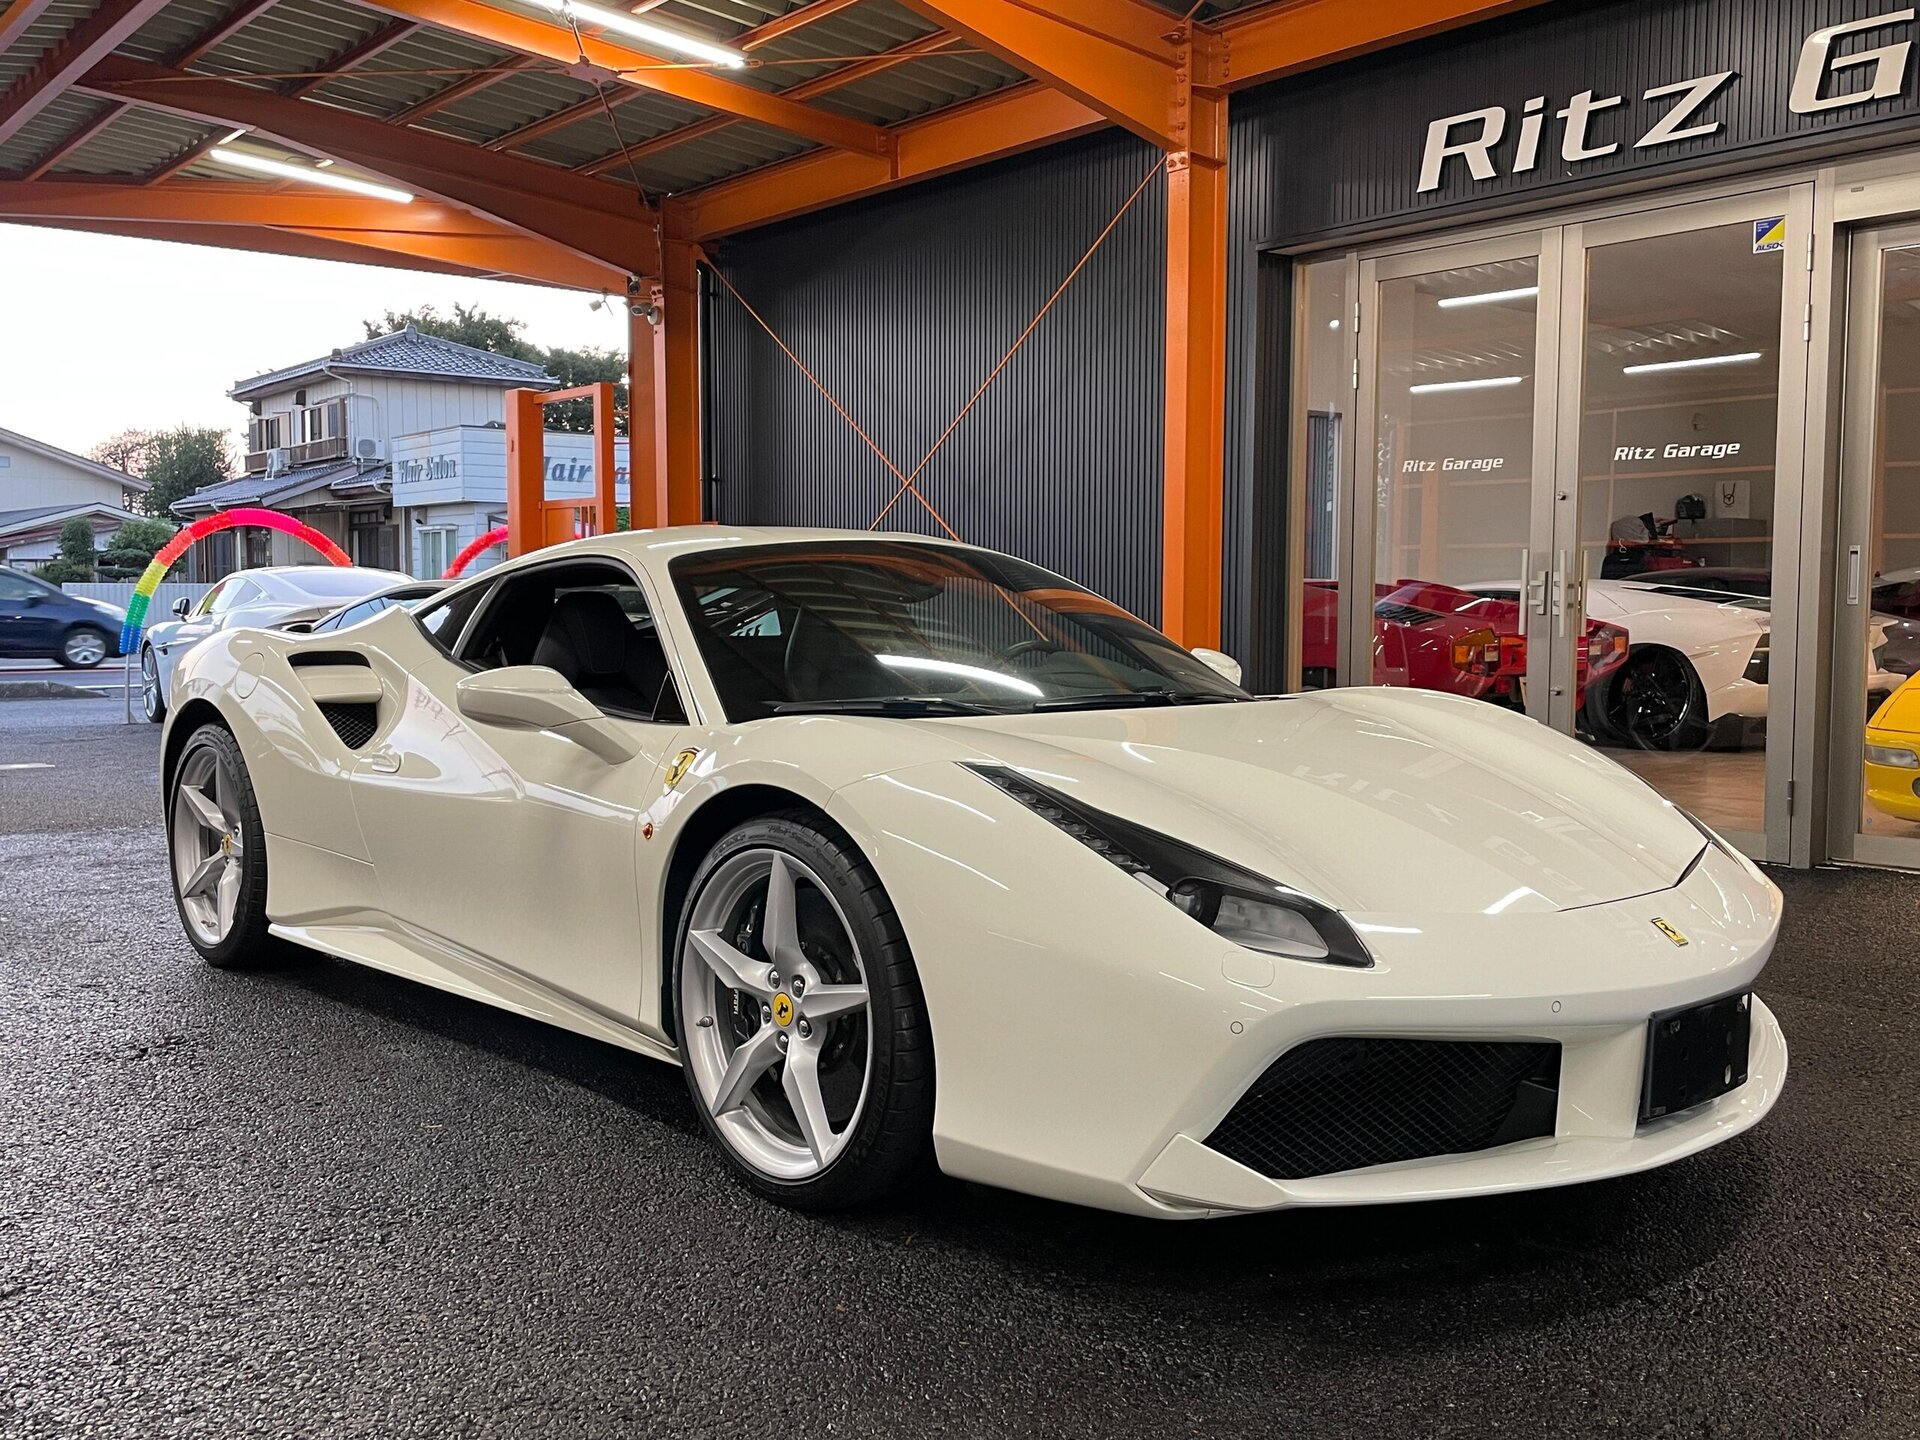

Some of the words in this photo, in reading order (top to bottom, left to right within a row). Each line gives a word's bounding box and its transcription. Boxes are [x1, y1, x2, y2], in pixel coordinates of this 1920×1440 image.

[1416, 70, 1734, 193] Ritz
[1613, 446, 1656, 461] Ritz
[1663, 442, 1741, 460] Garage
[398, 458, 423, 484] Hair
[425, 454, 457, 481] Salon
[1402, 459, 1437, 473] Ritz
[1442, 457, 1504, 472] Garage
